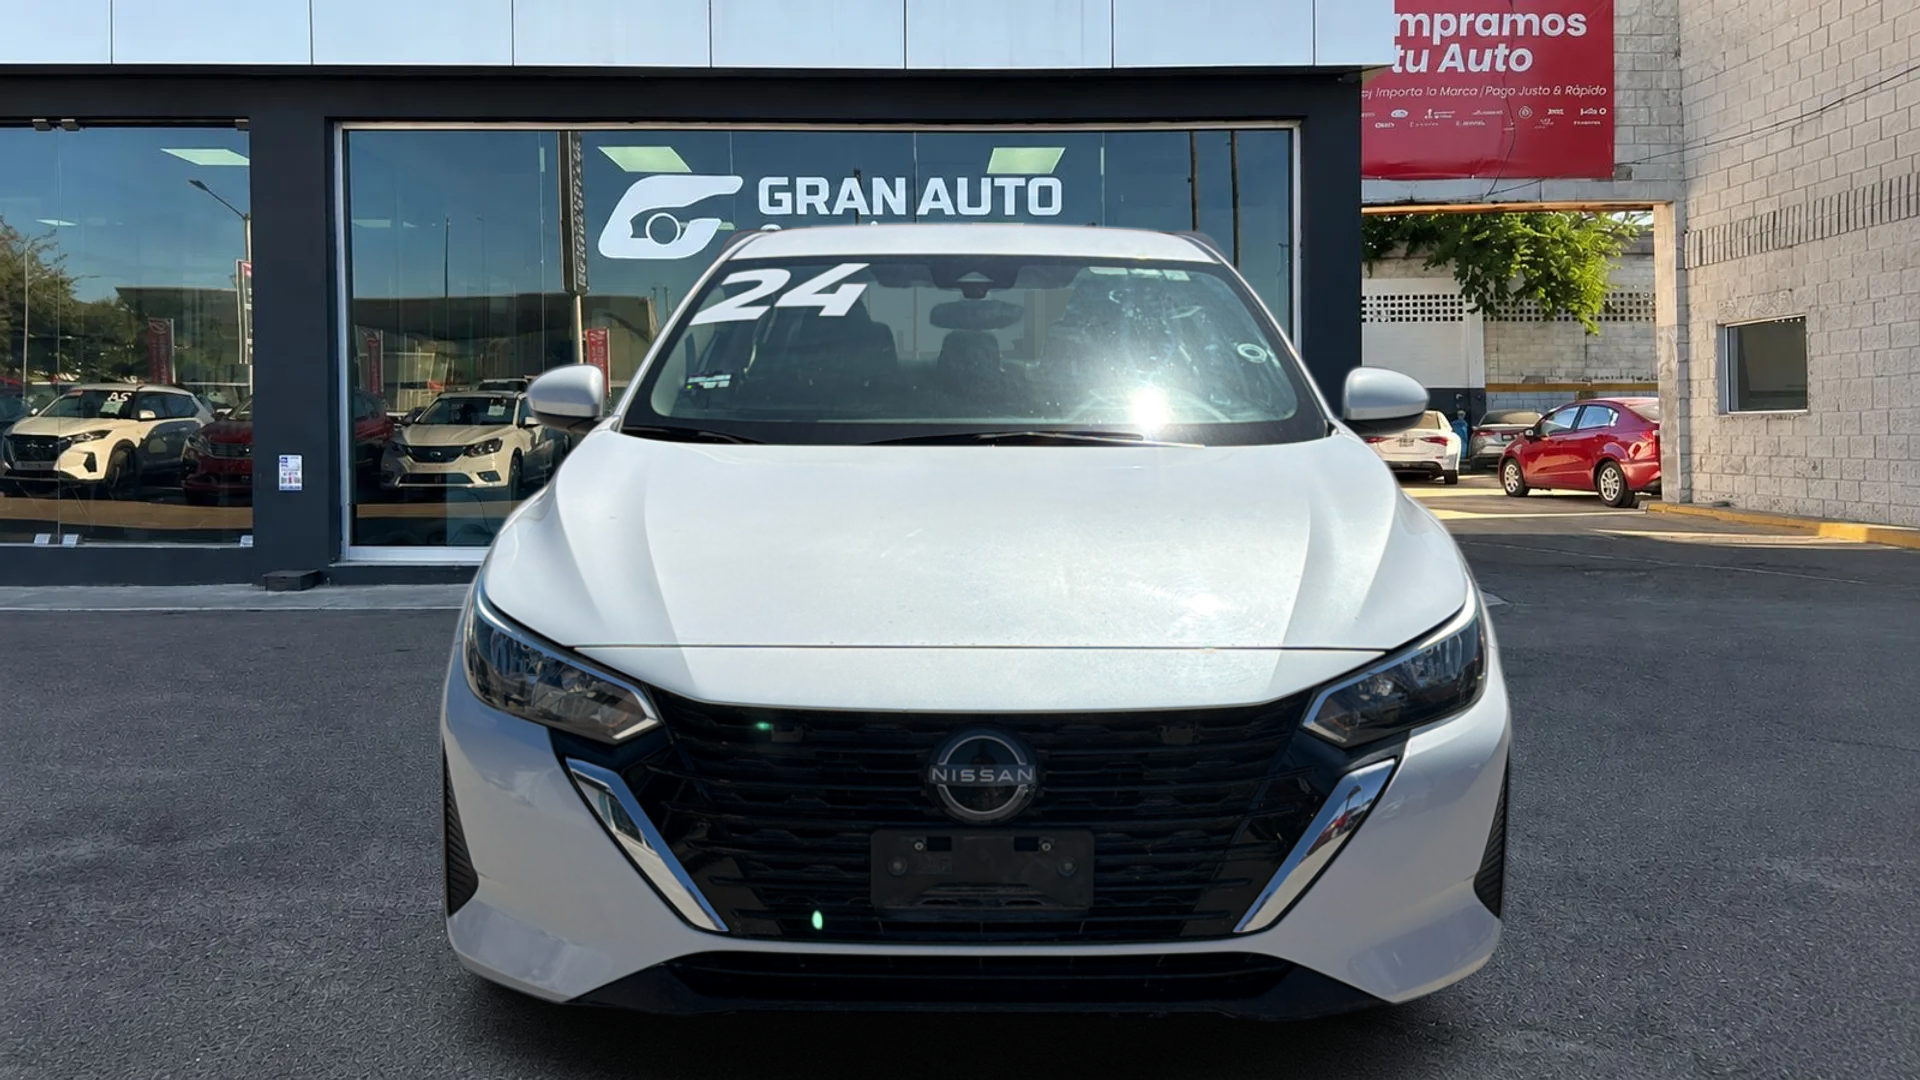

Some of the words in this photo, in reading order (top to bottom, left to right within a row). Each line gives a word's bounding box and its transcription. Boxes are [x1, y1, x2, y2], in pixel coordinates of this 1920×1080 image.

[1392, 44, 1429, 73] tu
[1437, 43, 1533, 73] Auto
[1376, 87, 1423, 99] Importa
[1426, 86, 1437, 96] la
[1440, 86, 1478, 97] Marca
[1518, 85, 1551, 96] Justo
[1553, 85, 1562, 96] &
[758, 176, 907, 216] GRAN
[916, 176, 1062, 216] AUTO
[690, 262, 871, 326] 24
[931, 768, 1033, 783] NISSAN
